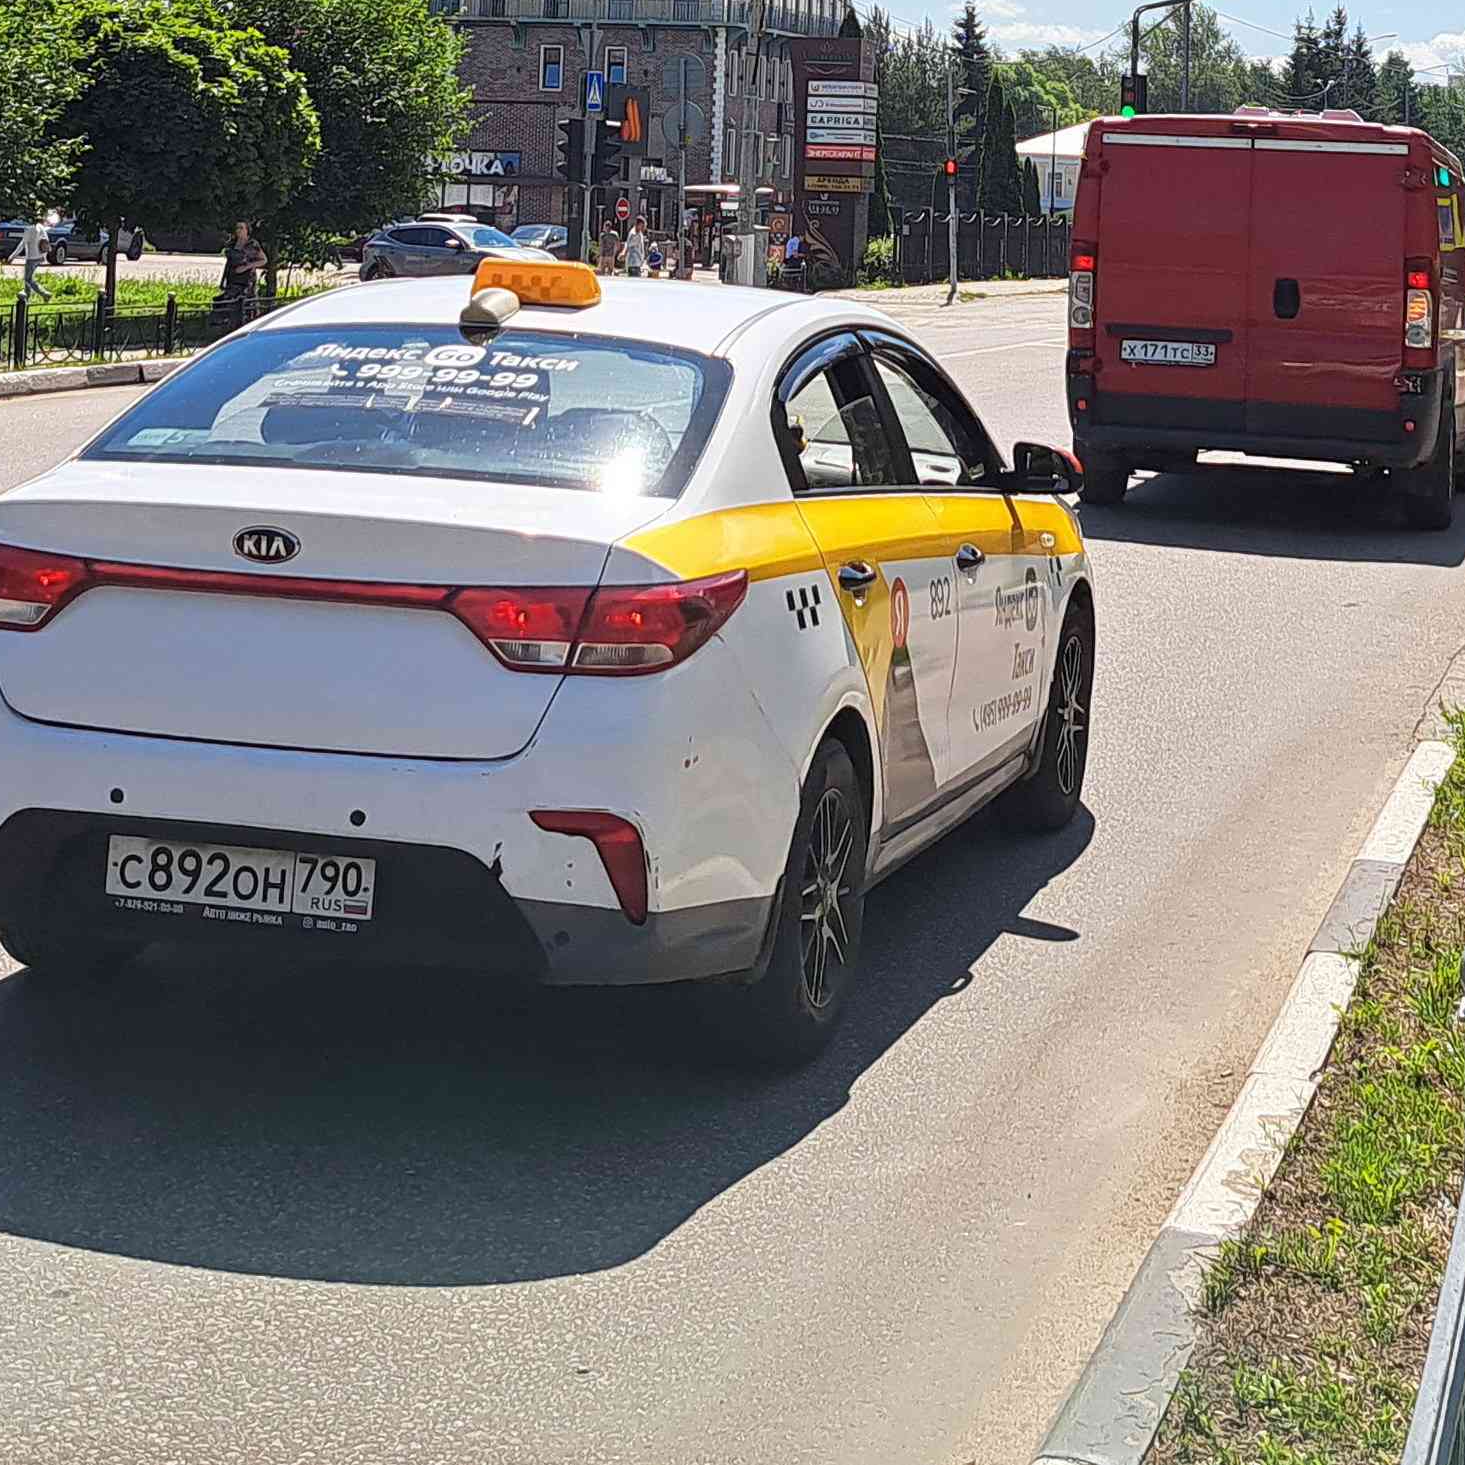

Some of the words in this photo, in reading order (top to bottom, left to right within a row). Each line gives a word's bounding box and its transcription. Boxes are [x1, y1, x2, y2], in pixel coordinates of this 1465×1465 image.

[313, 343, 424, 364] Яндекс
[488, 351, 580, 373] Такси
[1194, 344, 1210, 357] 33
[355, 362, 539, 388] 999-99-99
[466, 386, 517, 400] Google
[243, 534, 287, 557] KIA
[929, 576, 952, 621] 892
[1011, 642, 1036, 681] Такси
[118, 845, 288, 905] С892ОН
[298, 856, 363, 898] 790
[309, 896, 343, 912] RUS
